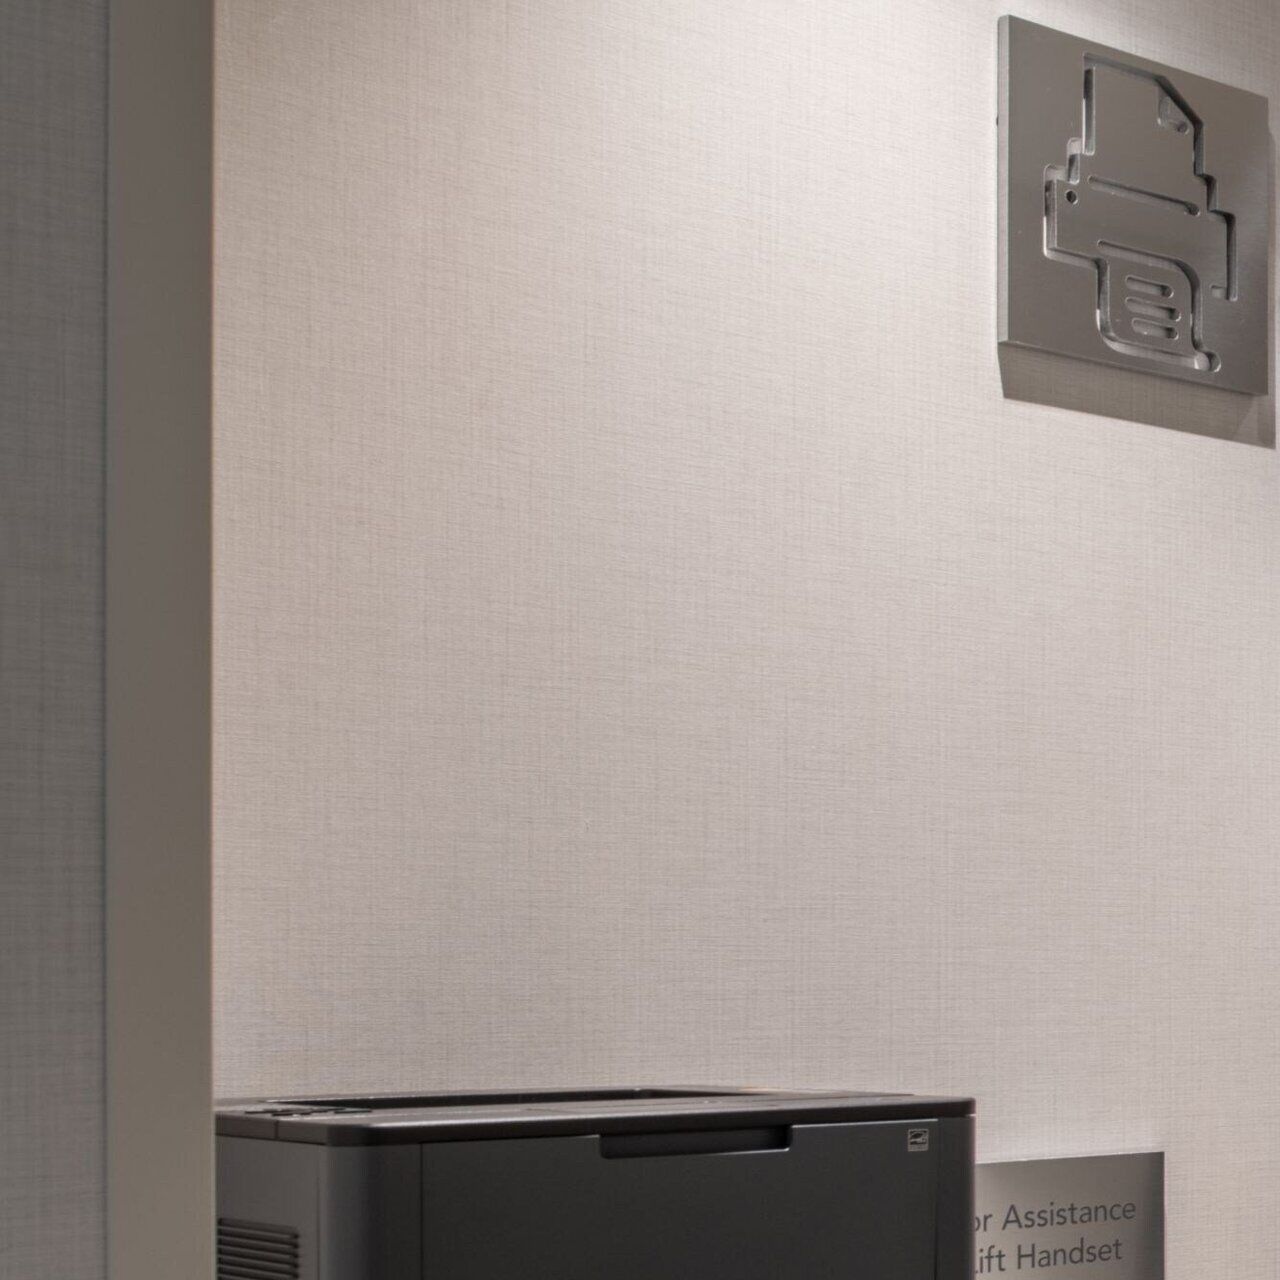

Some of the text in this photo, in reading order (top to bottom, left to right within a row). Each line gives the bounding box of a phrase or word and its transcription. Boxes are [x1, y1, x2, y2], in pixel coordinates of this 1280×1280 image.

[1002, 1201, 1137, 1231] Assistance
[974, 1237, 1123, 1274] ift Handset
